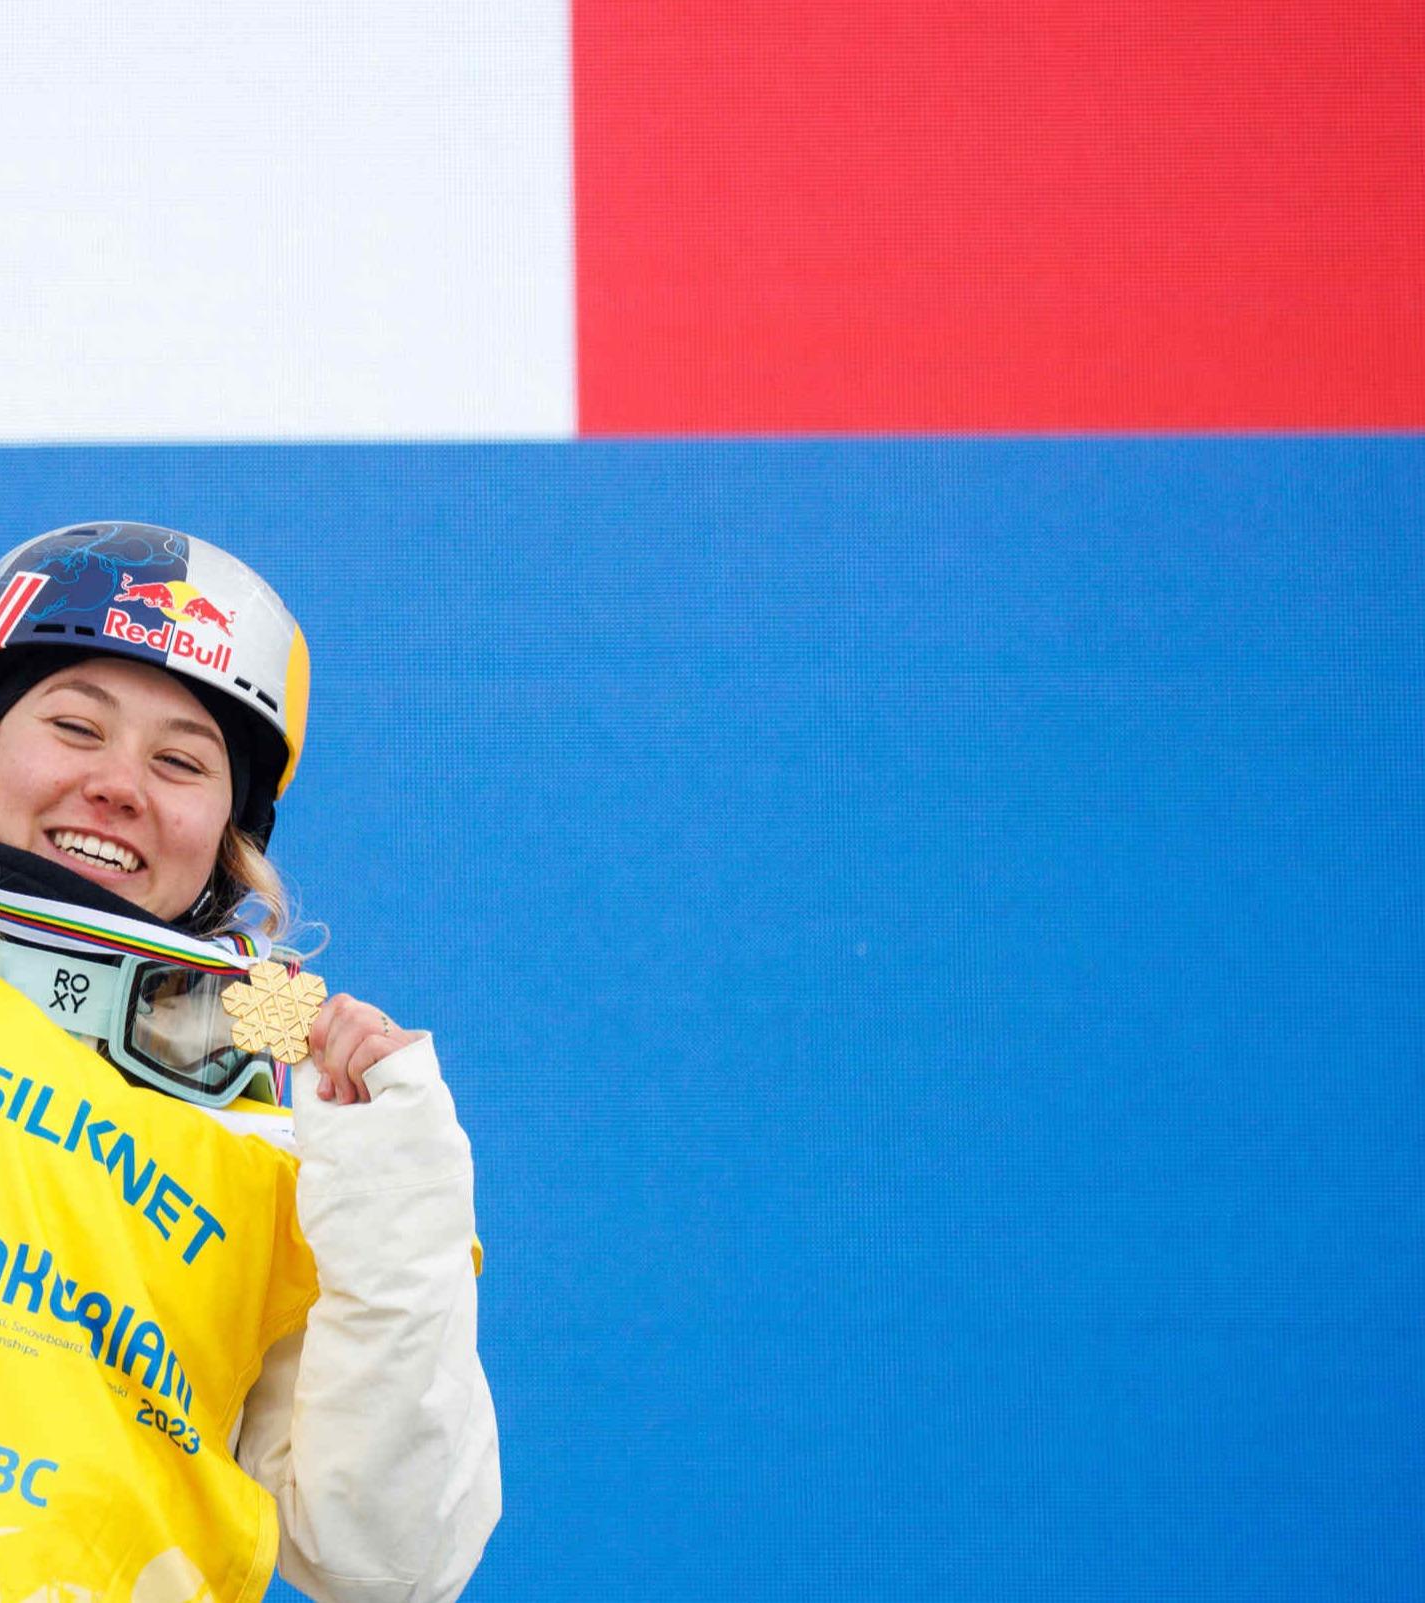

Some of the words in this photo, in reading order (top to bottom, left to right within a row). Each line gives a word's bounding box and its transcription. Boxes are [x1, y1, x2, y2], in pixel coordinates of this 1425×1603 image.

[105, 608, 172, 650] Red
[172, 629, 232, 673] Bull
[54, 968, 90, 994] RO
[49, 989, 87, 1014] XY
[12, 1320, 84, 1354] Snowboard
[136, 1398, 200, 1454] 2023
